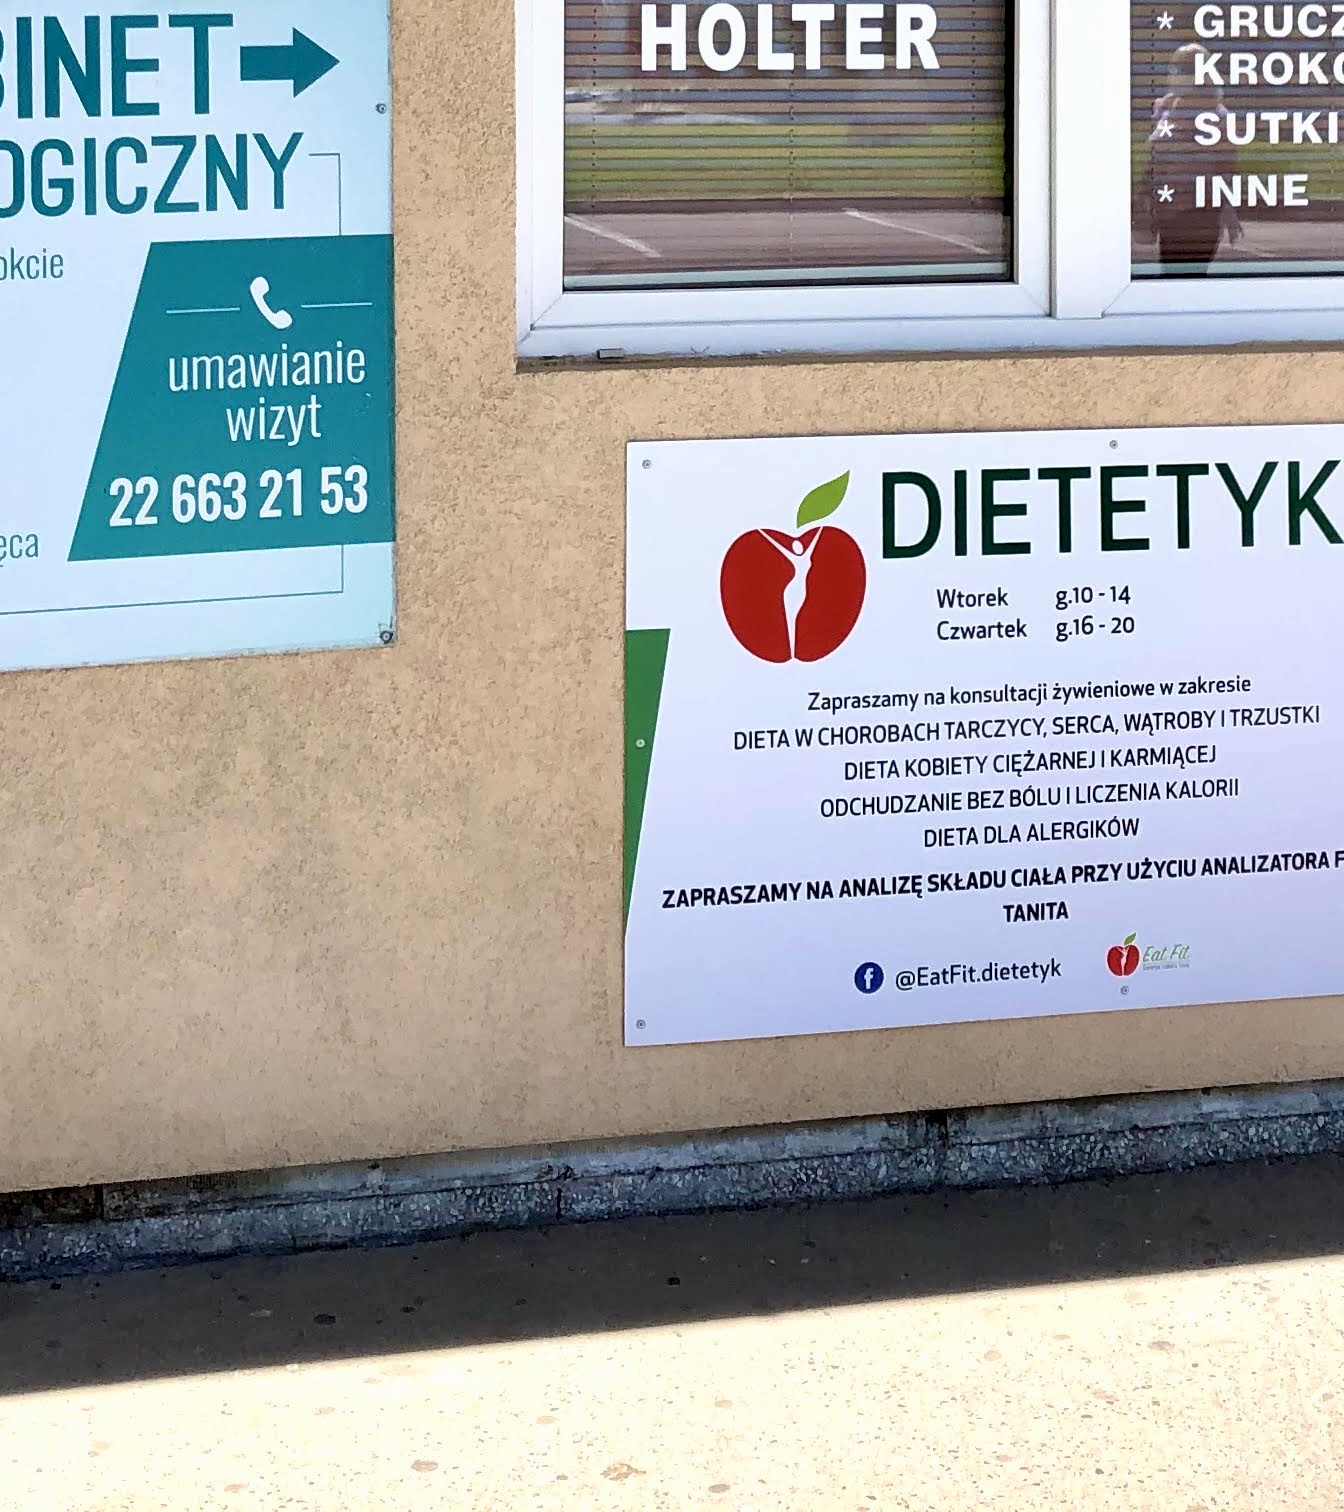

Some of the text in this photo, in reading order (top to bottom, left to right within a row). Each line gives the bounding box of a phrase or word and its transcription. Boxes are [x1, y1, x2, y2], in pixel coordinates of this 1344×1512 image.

[642, 3, 939, 71] HOLTER
[1195, 112, 1338, 145] SUTKI
[1196, 174, 1308, 207] INNE
[170, 341, 365, 391] umawianie
[226, 395, 322, 446] wizyt
[110, 465, 367, 526] 22 663 21 53
[883, 460, 1344, 559] DIETETYK
[937, 587, 1008, 608] Wtorek
[1056, 587, 1093, 610] g.10
[1110, 586, 1131, 604] 14
[937, 619, 1027, 640] Czwartek
[1056, 616, 1093, 642] g.16
[1111, 617, 1134, 633] 20
[808, 675, 1250, 715] Zapraszamy na konsultacji żywieniowe w zakresie
[735, 706, 1319, 750] DIETA W CHOROBACH TARCZYCY, SERCA, WĄTROBY I TRZUSTKI
[845, 745, 1215, 780] DIETA KOBIETY CIĘŻARNEJ I KARMIĄCEJ
[821, 779, 1238, 817] ODCHUDZANIE BEZ BÓLU I LICZENIA KALORII
[925, 816, 1139, 847] DIETA DLA ALERGIKÓW
[662, 883, 802, 908] ZAPRASZAMY
[807, 881, 833, 900] NA
[839, 875, 922, 898] ANALIZĘ
[928, 870, 1006, 892] SKŁADU
[1011, 867, 1066, 887] CIAŁA
[1072, 863, 1122, 883] PRZY
[1127, 858, 1196, 880] UŻYCIU
[1201, 852, 1329, 876] ANALIZATORA
[1003, 902, 1068, 922] TANITA
[1142, 944, 1191, 963] Eat Fit
[896, 958, 1061, 990] @EatFit.dietetyk
